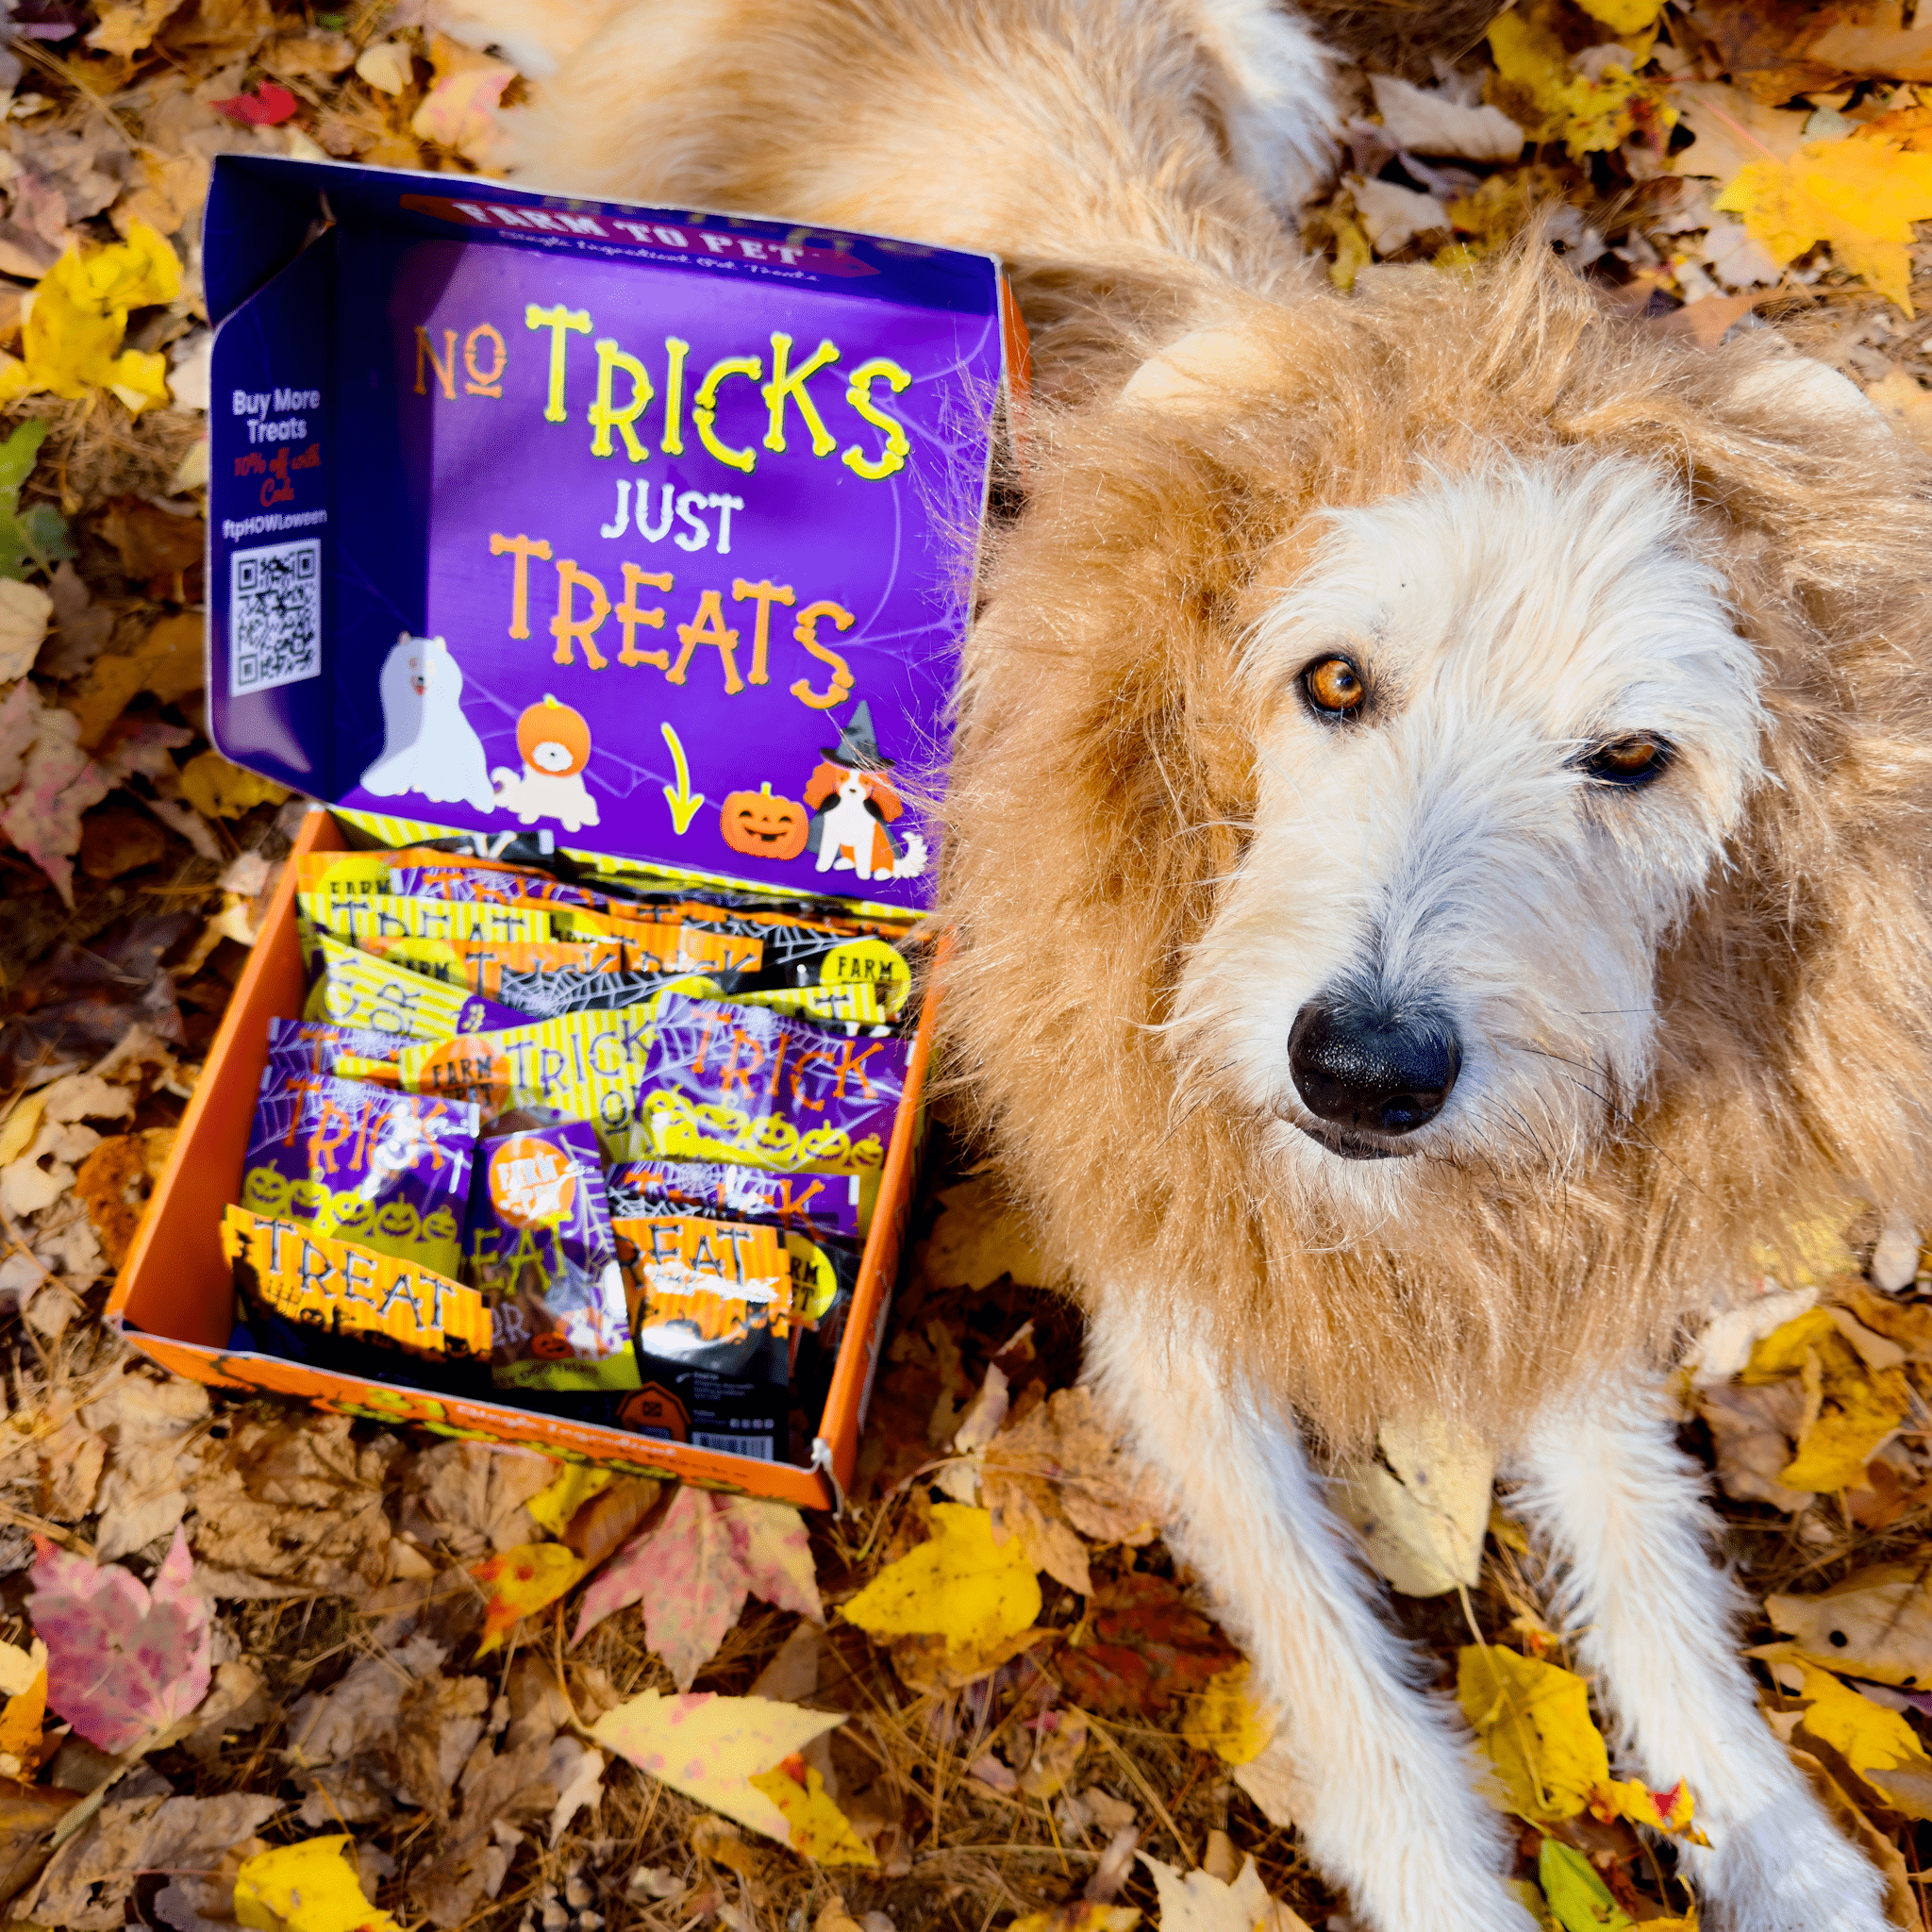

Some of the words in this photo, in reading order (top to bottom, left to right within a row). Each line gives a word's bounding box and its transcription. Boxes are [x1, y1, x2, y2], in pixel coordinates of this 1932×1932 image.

[452, 201, 609, 238] FARM
[613, 220, 690, 248] TO
[699, 232, 805, 265] PET
[413, 323, 508, 400] NO
[525, 303, 913, 480] TRICKS
[232, 390, 272, 422] Buy
[274, 388, 321, 412] More
[246, 417, 308, 443] Treats
[600, 478, 745, 555] JUST
[490, 532, 856, 709] TREATS
[837, 956, 893, 982] FARM
[431, 1056, 492, 1089] FARM
[504, 1017, 655, 1098] TRICK
[691, 1007, 885, 1111] TRICK
[254, 1217, 457, 1333] TREAT
